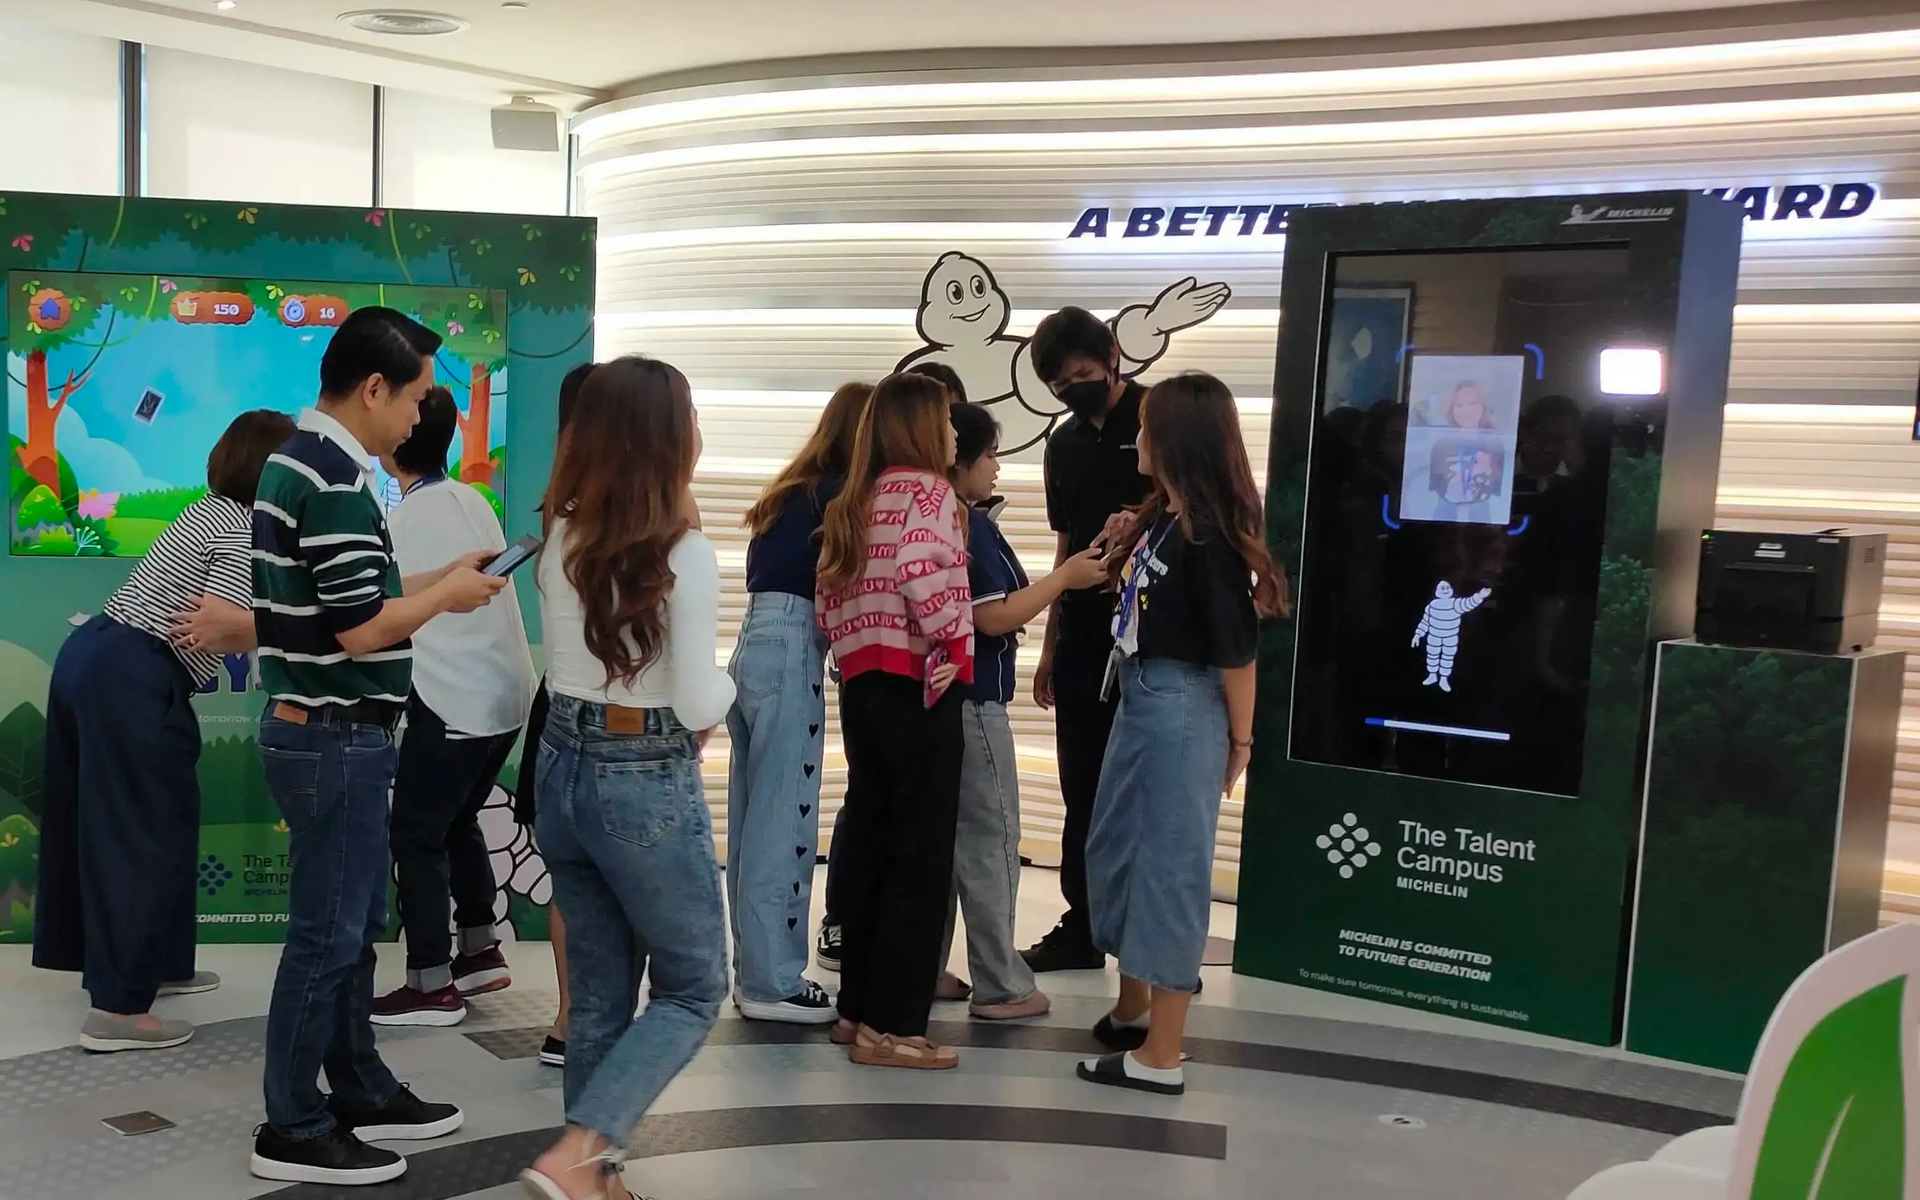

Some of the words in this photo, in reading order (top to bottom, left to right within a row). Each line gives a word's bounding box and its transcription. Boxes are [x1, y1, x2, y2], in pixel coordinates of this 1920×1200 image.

[1067, 207, 1110, 238] A
[1121, 204, 1296, 238] BETTE
[1711, 183, 1877, 220] ARD
[1606, 207, 1675, 219] MICHELIN
[213, 304, 240, 315] 150
[319, 307, 336, 319] 16
[1398, 820, 1447, 848] The
[1454, 828, 1537, 861] Talent
[242, 854, 272, 868] The
[276, 854, 293, 868] Ta
[1397, 847, 1503, 882] Campus
[243, 870, 290, 885] Camp
[1396, 876, 1468, 898] MICHELIN
[258, 913, 273, 923] TO
[274, 913, 290, 923] FU
[1338, 929, 1400, 950] MICHELIN
[1399, 940, 1414, 951] IS
[1414, 943, 1493, 966] COMMITTED
[1338, 945, 1356, 957] TO
[1356, 948, 1408, 966] FUTURE
[1408, 957, 1493, 982] GENERATION
[1298, 967, 1310, 978] To
[1310, 972, 1336, 984] make
[1336, 977, 1357, 988] sure
[1406, 990, 1459, 1010] everything
[1460, 1000, 1470, 1010] is
[1470, 1003, 1531, 1021] sustainable
